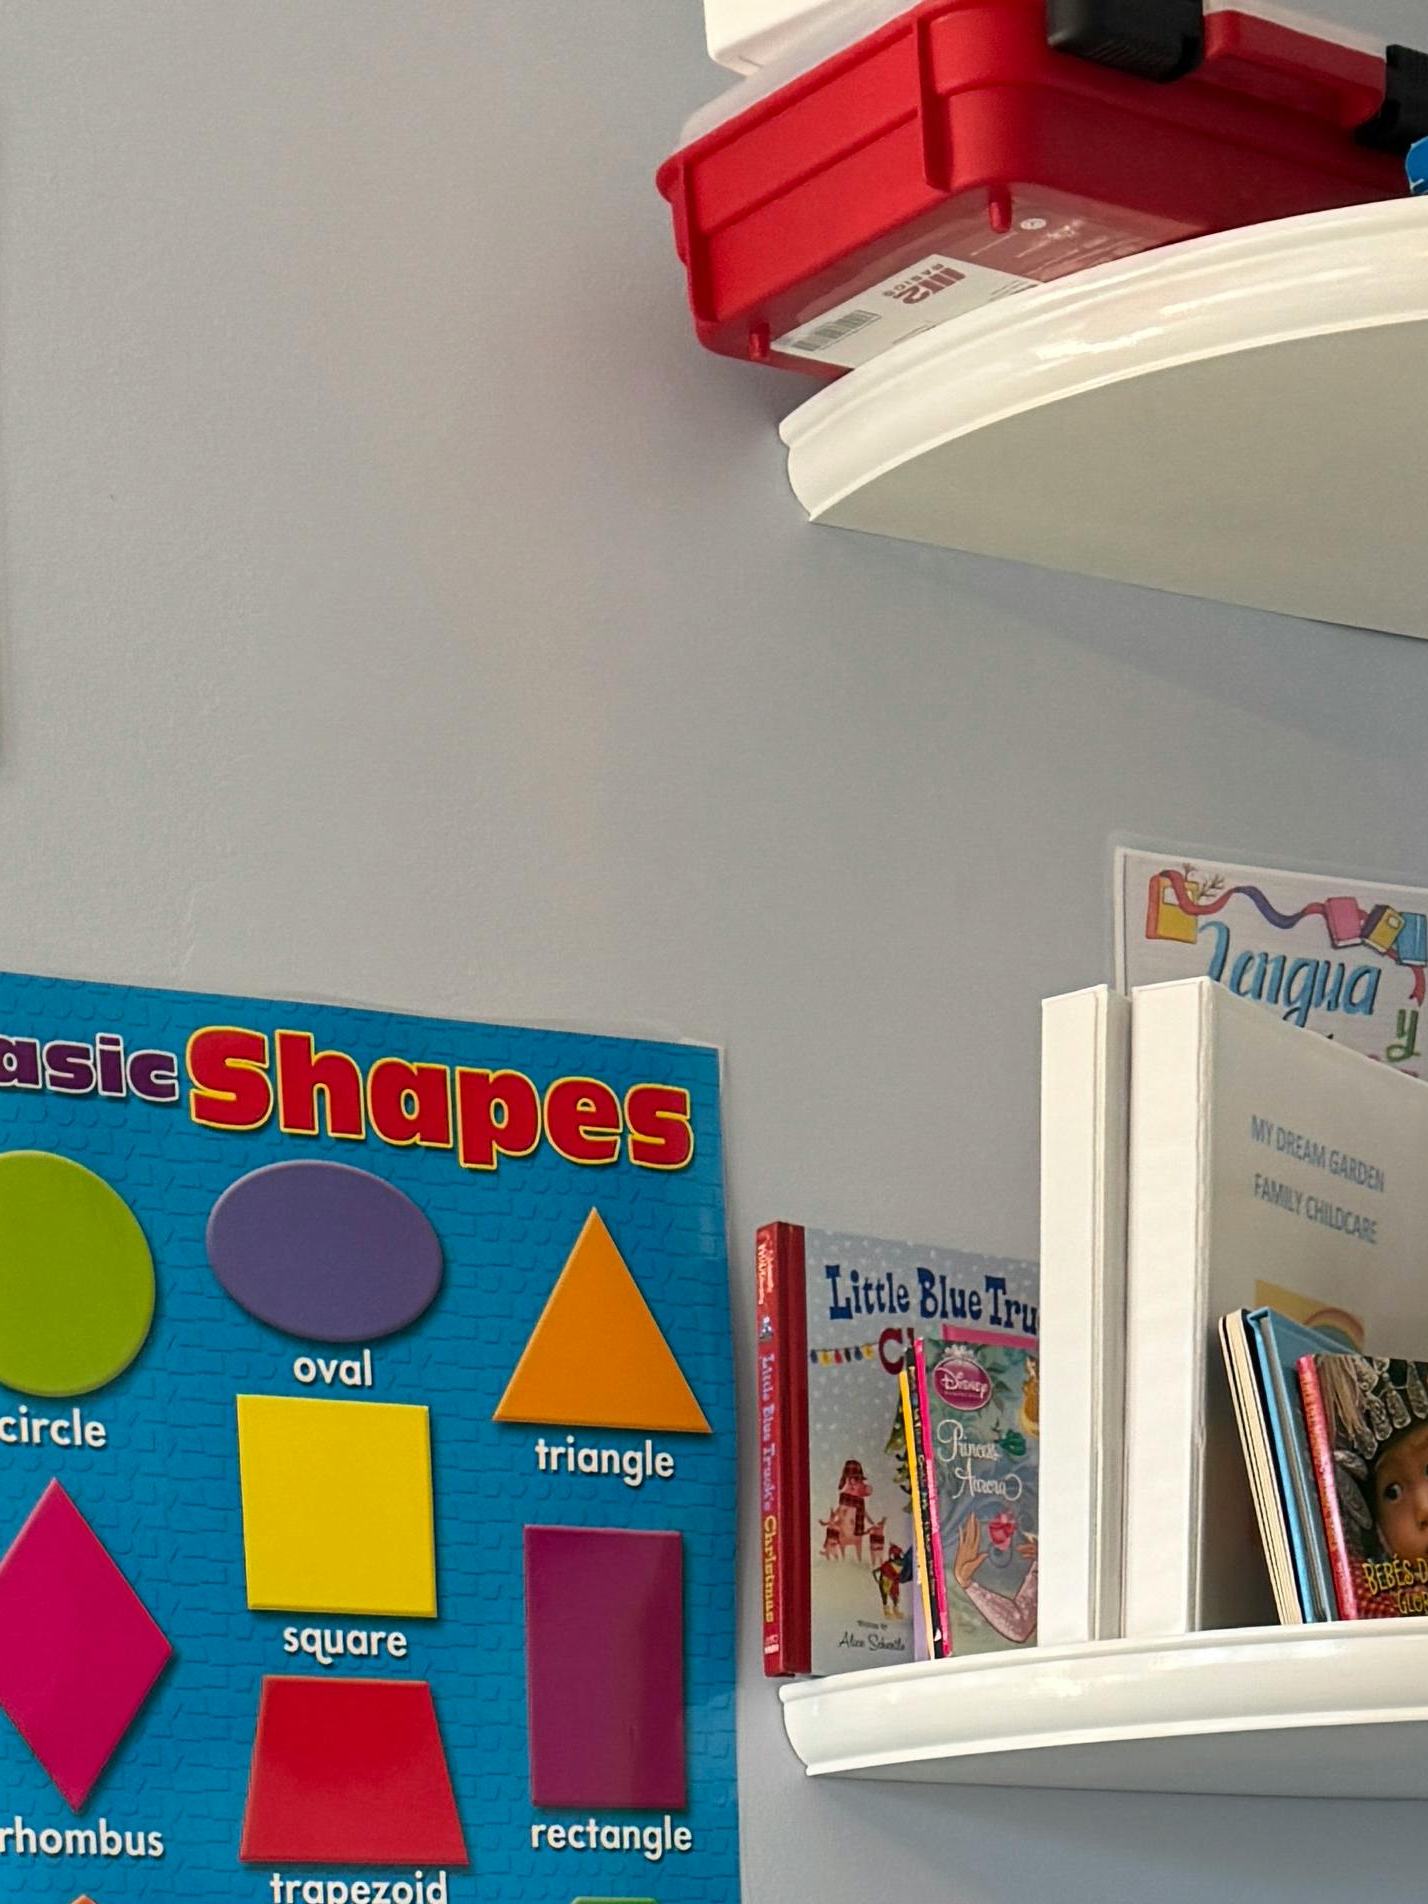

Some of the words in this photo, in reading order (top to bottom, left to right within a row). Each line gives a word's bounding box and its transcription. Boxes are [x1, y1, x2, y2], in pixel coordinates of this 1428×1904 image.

[1385, 1008, 1421, 1063] y
[185, 1025, 694, 1171] Shapes
[1251, 1115, 1273, 1144] MY
[1276, 1125, 1326, 1170] DREAM
[1328, 1150, 1385, 1194] GARDEN
[1254, 1173, 1305, 1216] FAMILY
[1305, 1195, 1378, 1245] CHILDCARE
[824, 1263, 911, 1321] Little
[916, 1266, 983, 1322] Blue
[984, 1275, 1040, 1336] Tru
[292, 1349, 374, 1387] oval
[760, 1353, 776, 1401] Little
[941, 1366, 989, 1400] Disney
[762, 1403, 777, 1442] Blue
[534, 1437, 675, 1486] triangle
[951, 1458, 1023, 1501] Aurora
[762, 1515, 779, 1625] Christmas
[283, 1624, 408, 1666] square
[530, 1816, 693, 1861] rectangle
